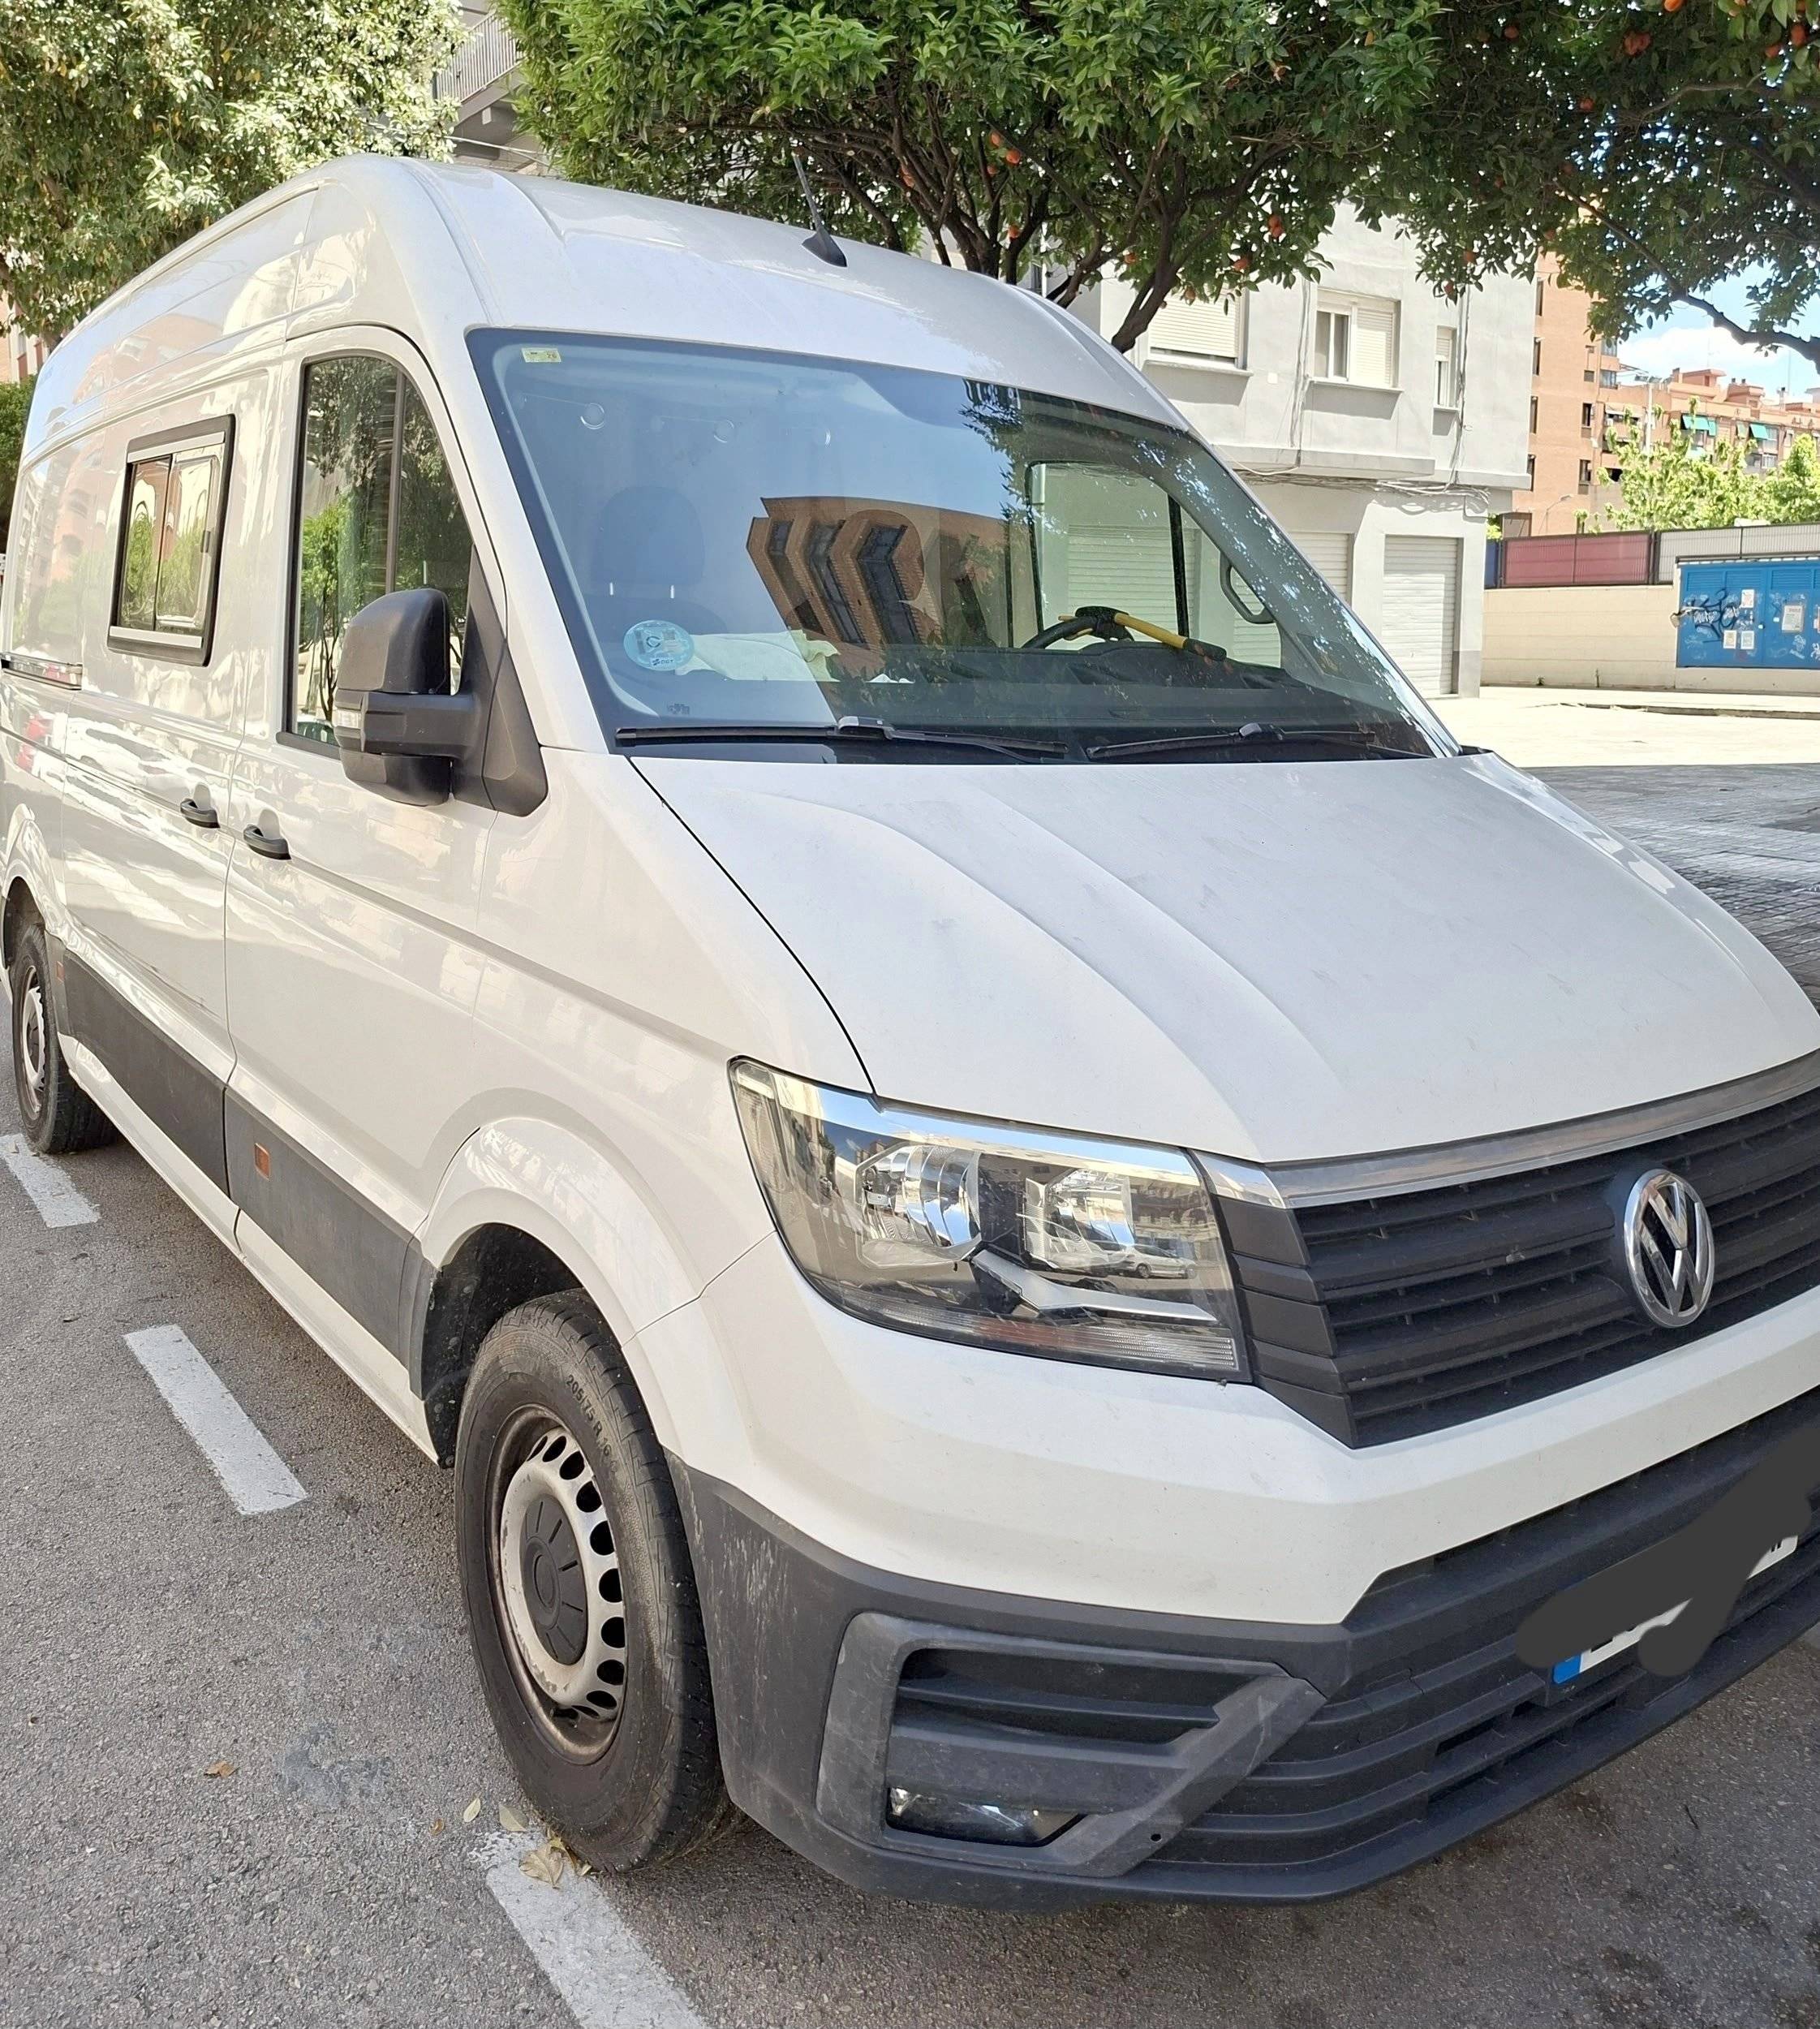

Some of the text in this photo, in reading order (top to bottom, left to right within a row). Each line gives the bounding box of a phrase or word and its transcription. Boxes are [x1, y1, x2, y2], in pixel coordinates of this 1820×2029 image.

[1629, 1174, 1710, 1320] VW
[566, 1374, 594, 1419] 205/75
[593, 1424, 603, 1435] R
[601, 1437, 612, 1456] 16
